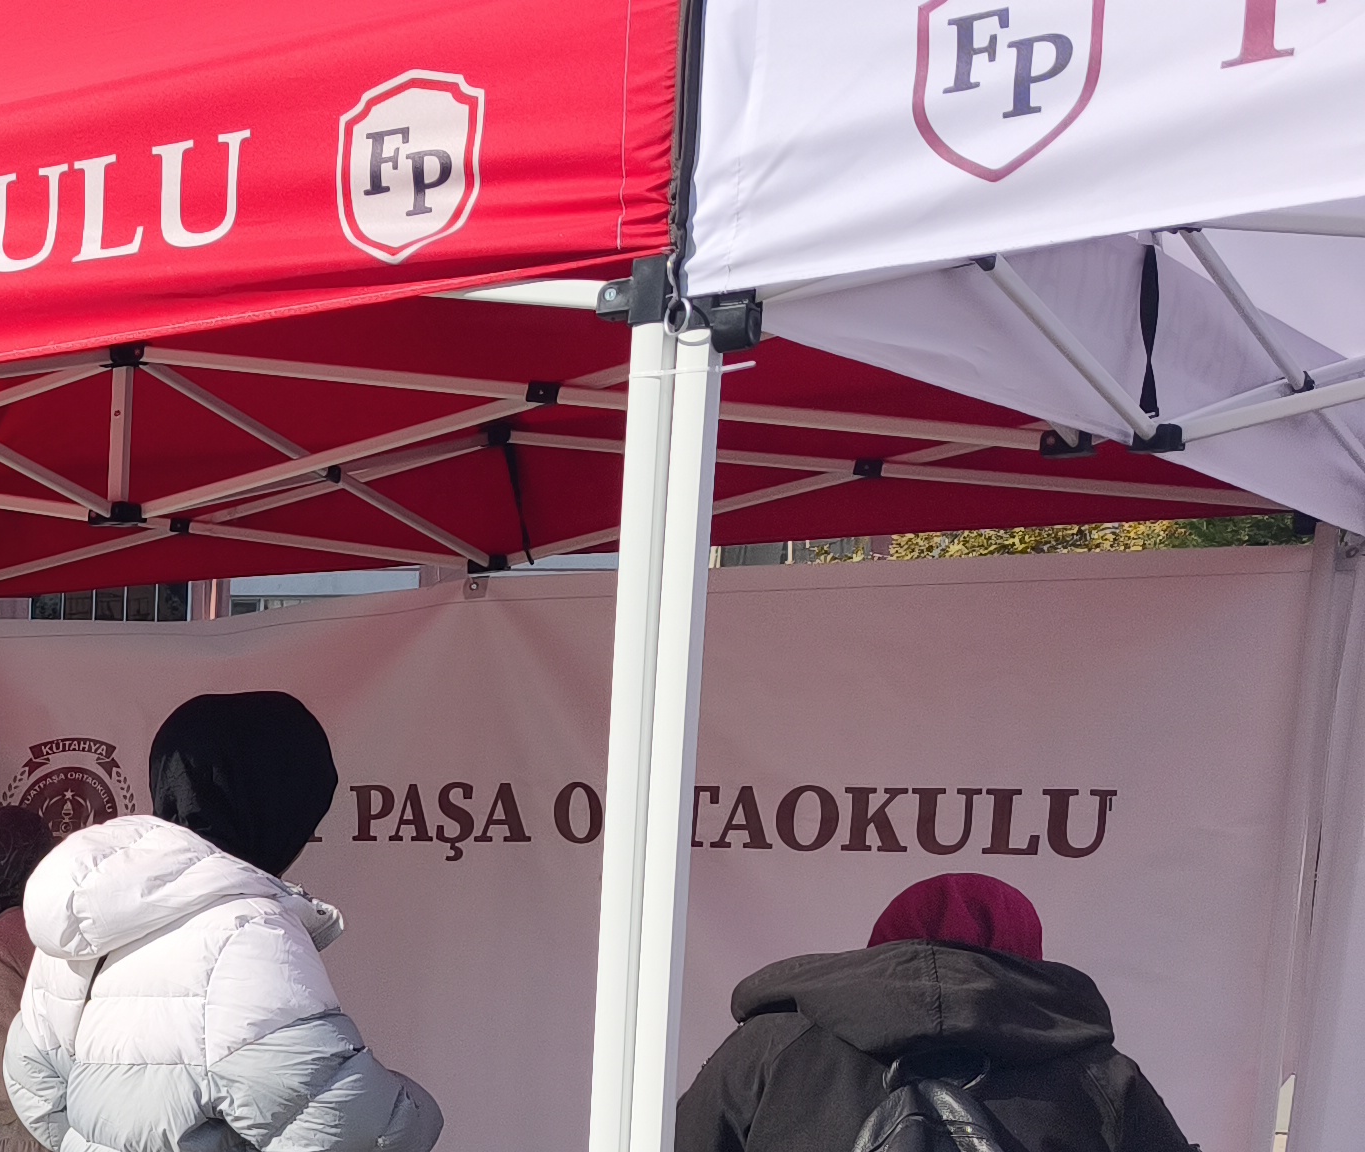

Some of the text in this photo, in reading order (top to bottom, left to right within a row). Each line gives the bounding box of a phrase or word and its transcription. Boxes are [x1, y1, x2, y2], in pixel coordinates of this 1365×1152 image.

[942, 6, 1074, 120] FP
[363, 125, 452, 218] FP
[41, 738, 108, 757] KÜTAHYA
[67, 771, 113, 813] ORTAOKULU
[350, 781, 531, 862] PAŞA
[554, 781, 1118, 860] OTAOKULU
